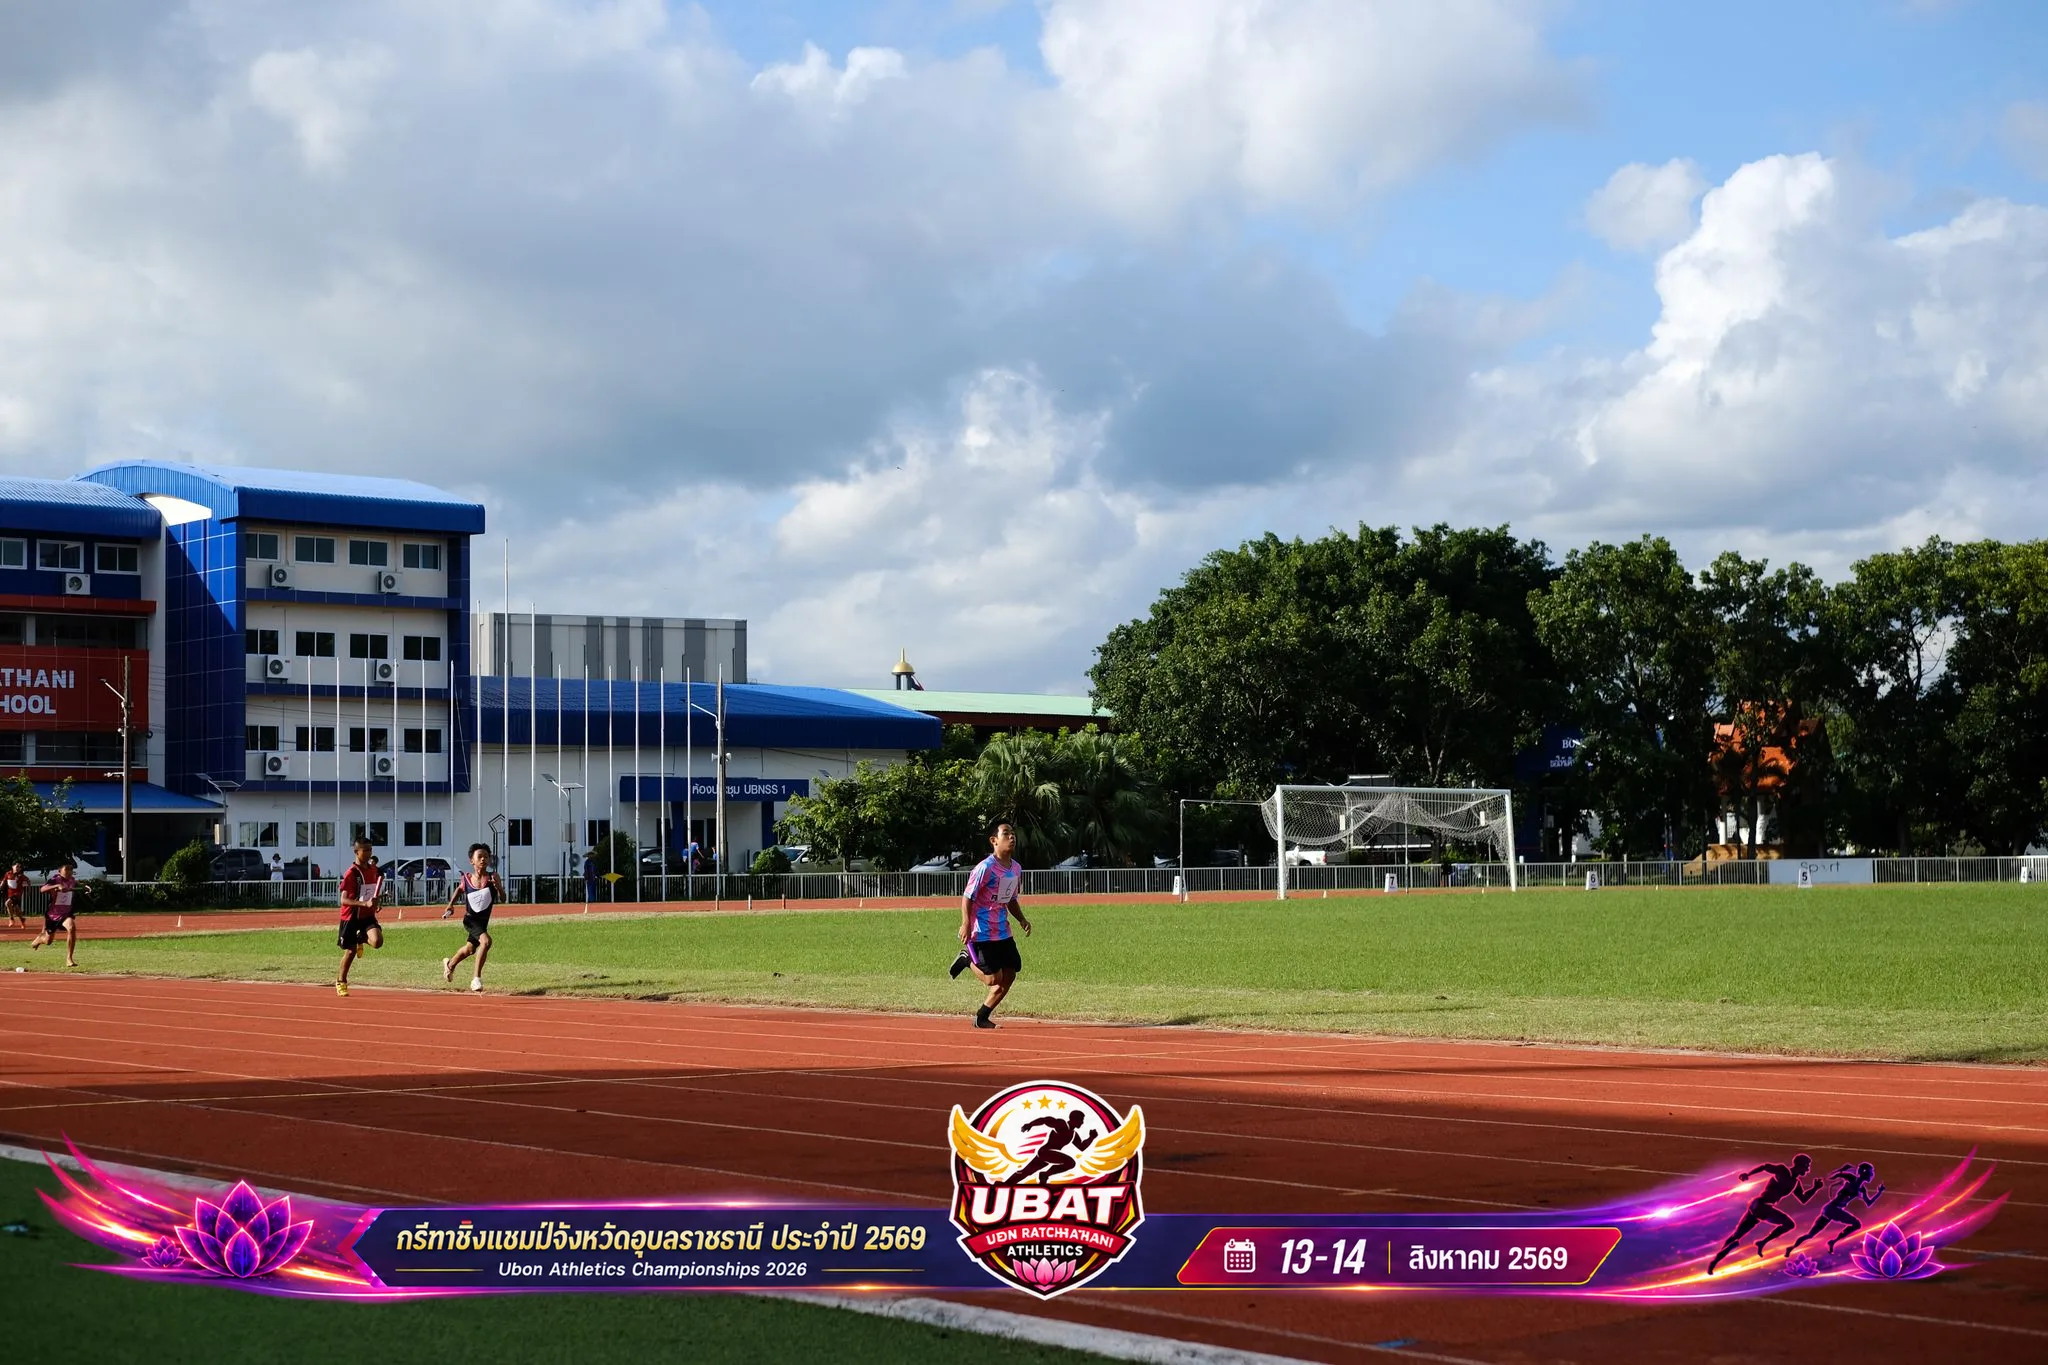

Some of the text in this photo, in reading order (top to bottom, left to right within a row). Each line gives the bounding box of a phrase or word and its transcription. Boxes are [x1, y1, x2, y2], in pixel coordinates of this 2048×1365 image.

[0, 668, 74, 688] THANI
[744, 784, 778, 795] UBNSS
[782, 785, 786, 794] 1
[1389, 876, 1395, 886] 7
[1590, 874, 1596, 883] 6
[1802, 872, 1808, 881] 5
[1005, 881, 1012, 896] 6
